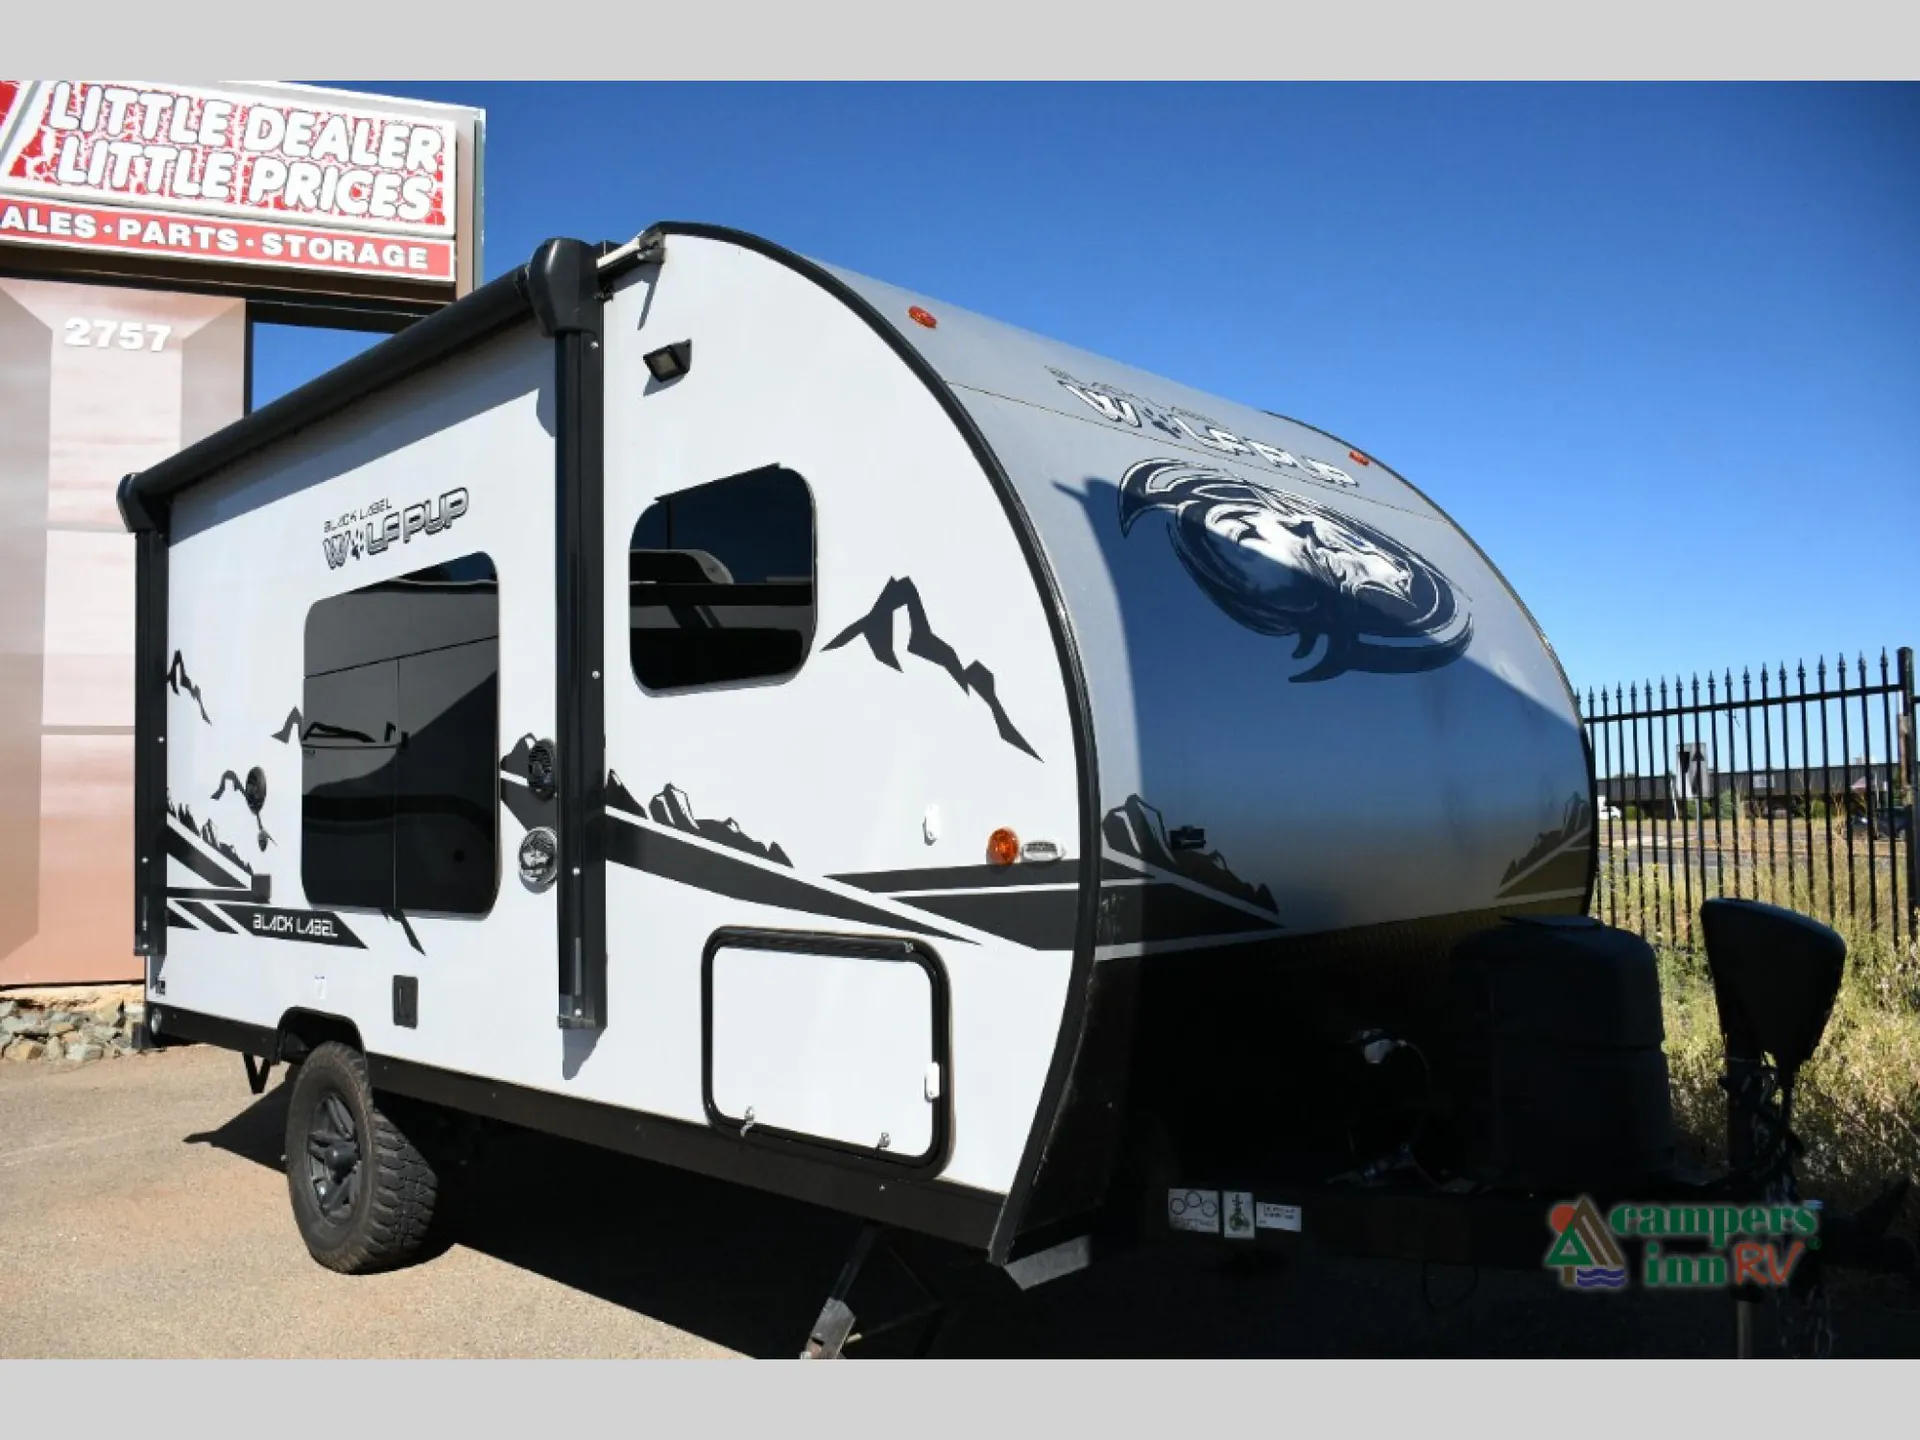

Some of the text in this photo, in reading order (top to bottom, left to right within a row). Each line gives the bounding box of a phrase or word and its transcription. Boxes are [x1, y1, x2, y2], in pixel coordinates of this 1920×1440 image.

[49, 81, 444, 173] LITTLE DEALER
[55, 134, 439, 222] LITTLE PRICES
[0, 205, 429, 270] ALES PARTS STORAGE
[63, 316, 173, 353] 2757
[253, 913, 338, 937] BLACK LABEL
